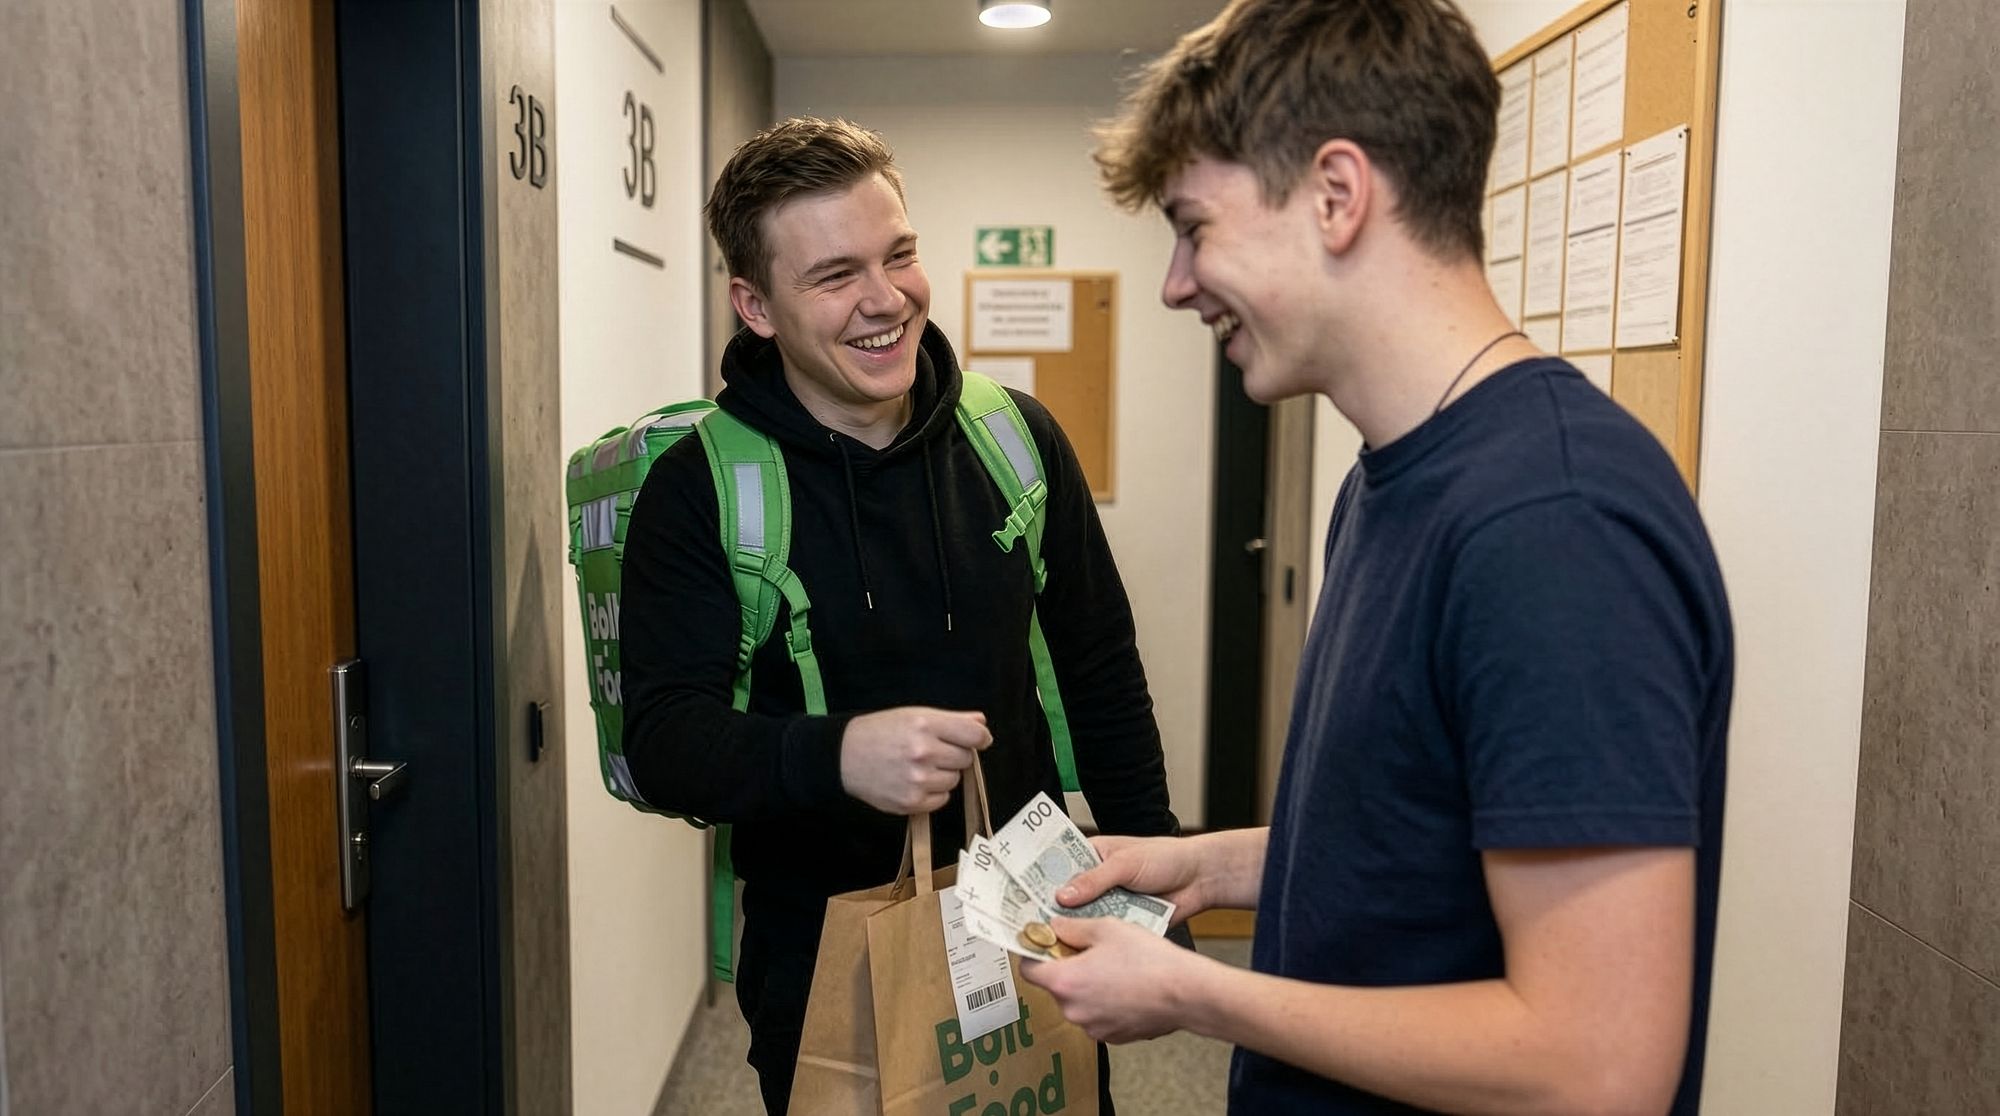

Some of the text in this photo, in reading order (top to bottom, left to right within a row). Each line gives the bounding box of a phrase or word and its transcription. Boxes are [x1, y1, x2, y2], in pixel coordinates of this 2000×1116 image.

[509, 84, 547, 190] 3B
[623, 90, 656, 209] 3B
[1022, 801, 1052, 832] 100
